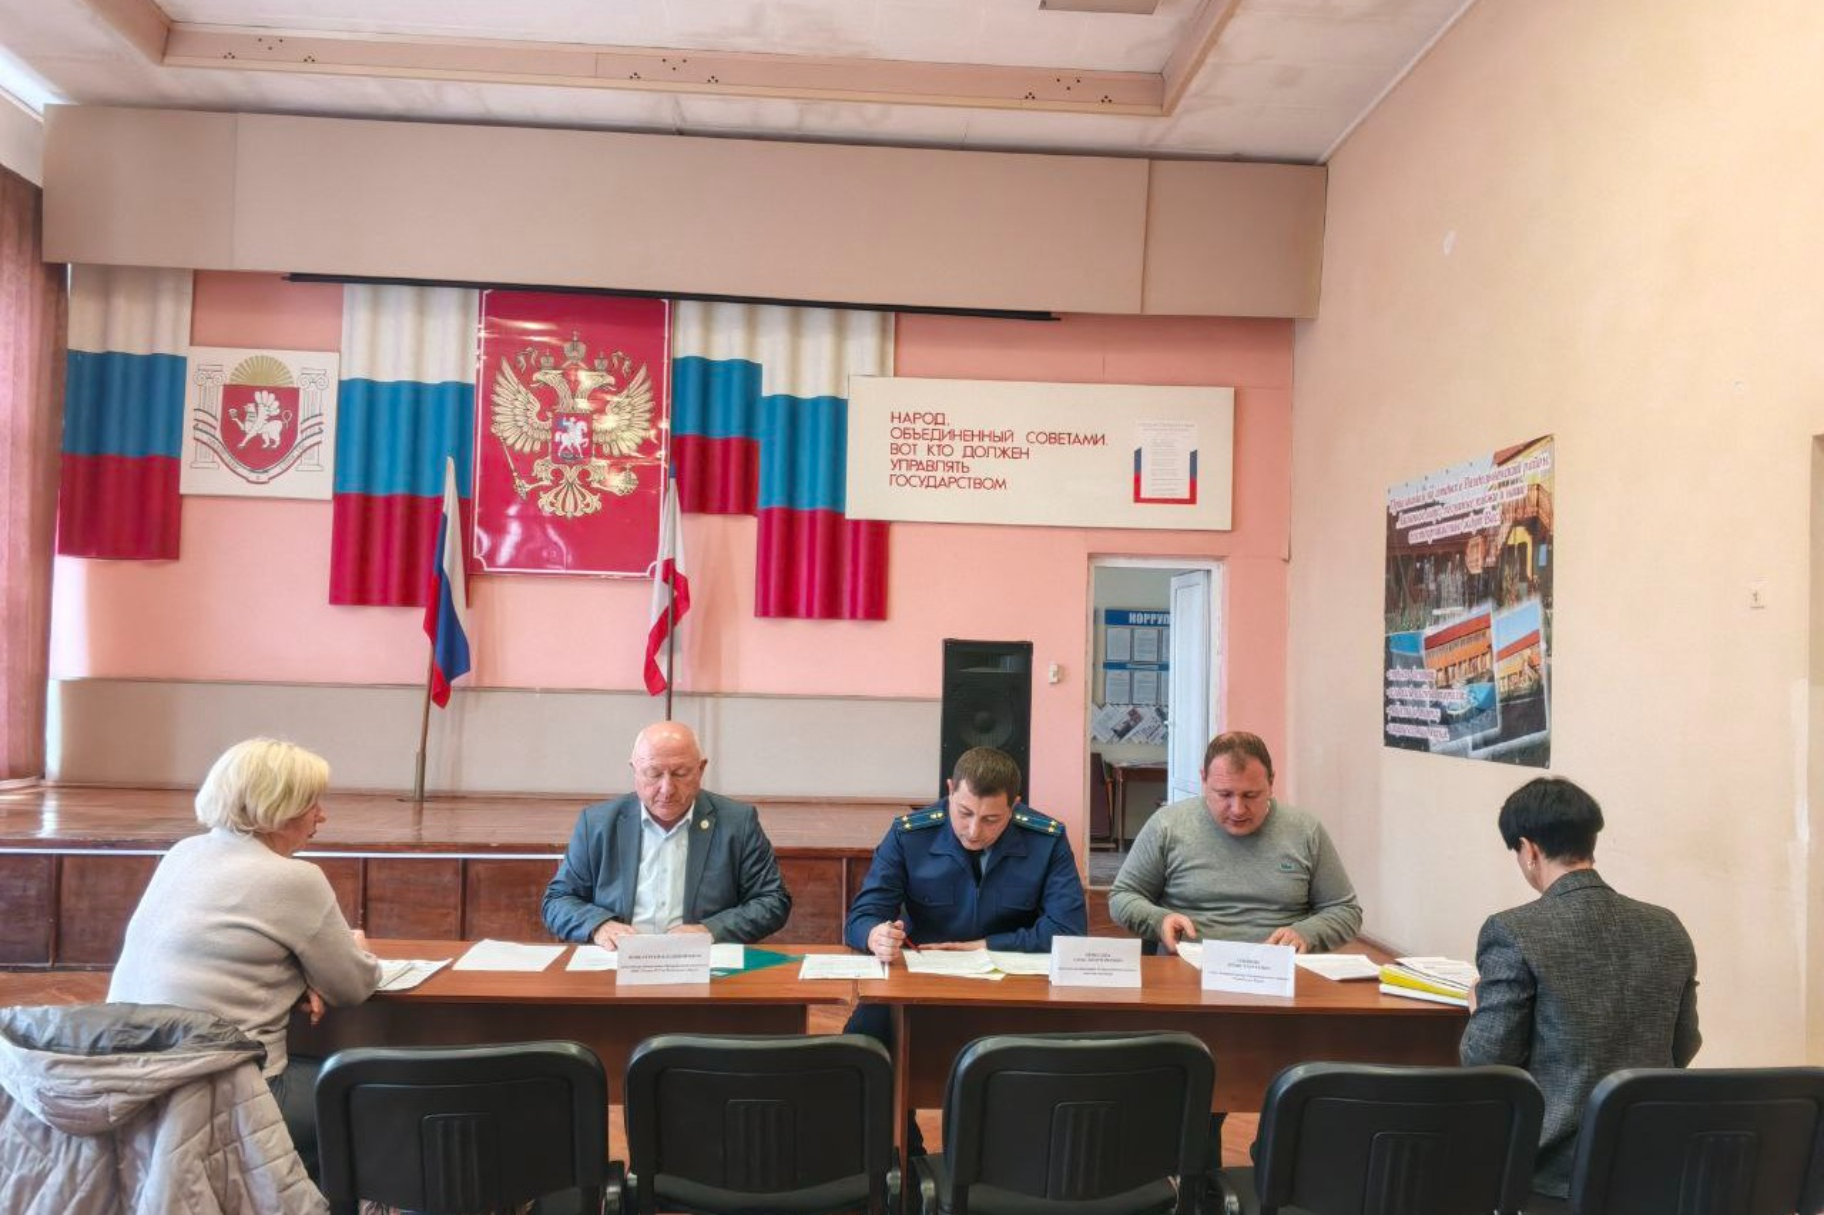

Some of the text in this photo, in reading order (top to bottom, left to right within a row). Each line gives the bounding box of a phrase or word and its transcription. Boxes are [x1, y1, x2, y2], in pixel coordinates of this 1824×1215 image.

[890, 443, 1030, 460] ВОТ КТО ДОЛЖЕН
[890, 458, 970, 473] УПРАВЛЯТЬ
[889, 474, 1007, 490] ГОСУДАРСТВОМ
